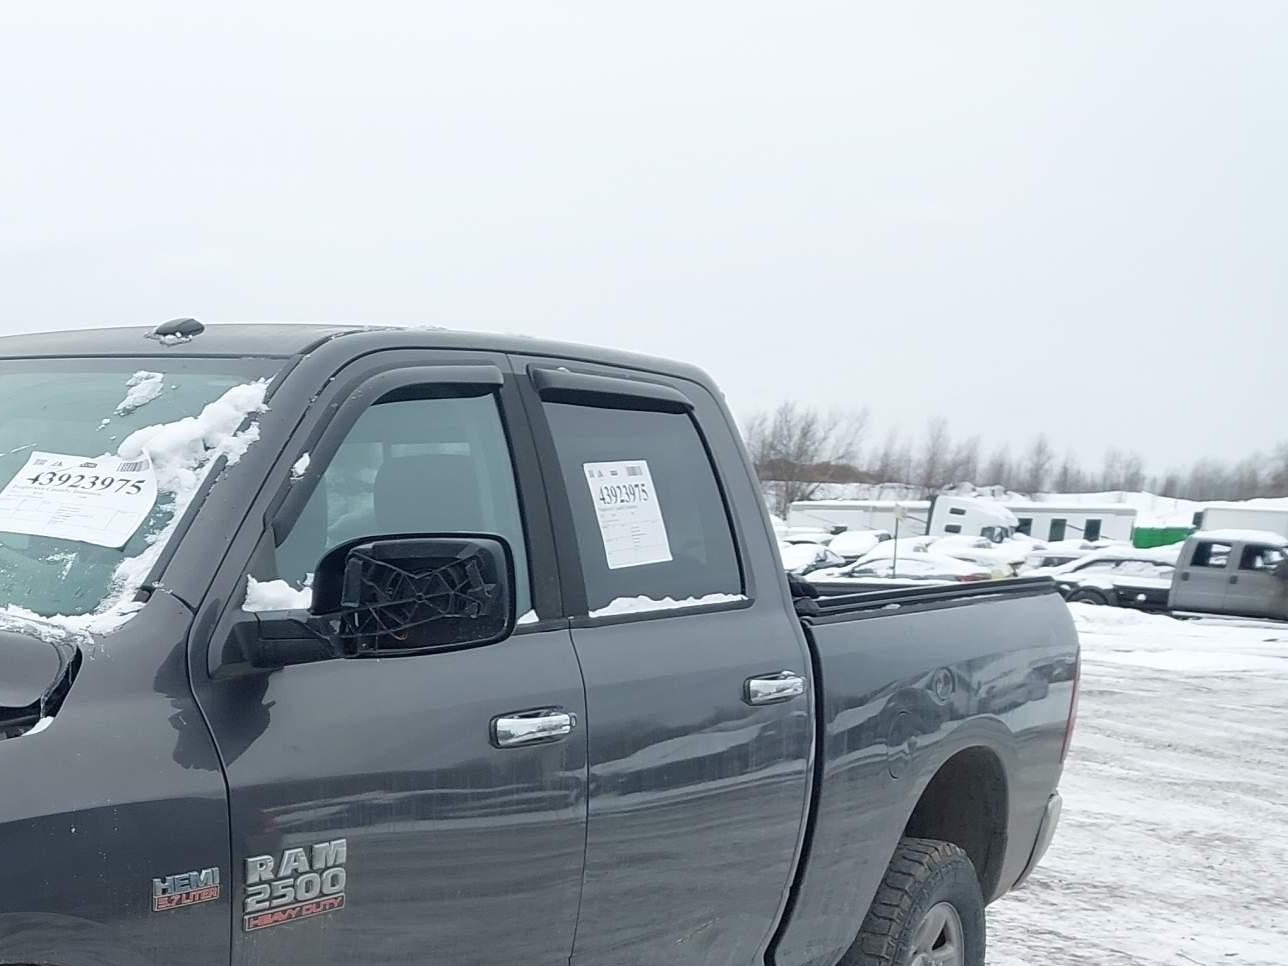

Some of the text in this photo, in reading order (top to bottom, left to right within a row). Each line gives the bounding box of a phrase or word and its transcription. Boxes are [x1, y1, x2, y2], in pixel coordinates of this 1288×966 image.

[26, 471, 146, 496] 43923975
[599, 483, 649, 505] 43923975
[245, 839, 347, 884] RAM
[152, 867, 220, 897] HEMI
[181, 887, 218, 905] LITER
[245, 867, 347, 913] 2500
[248, 897, 343, 929] HEAVY DUTY
